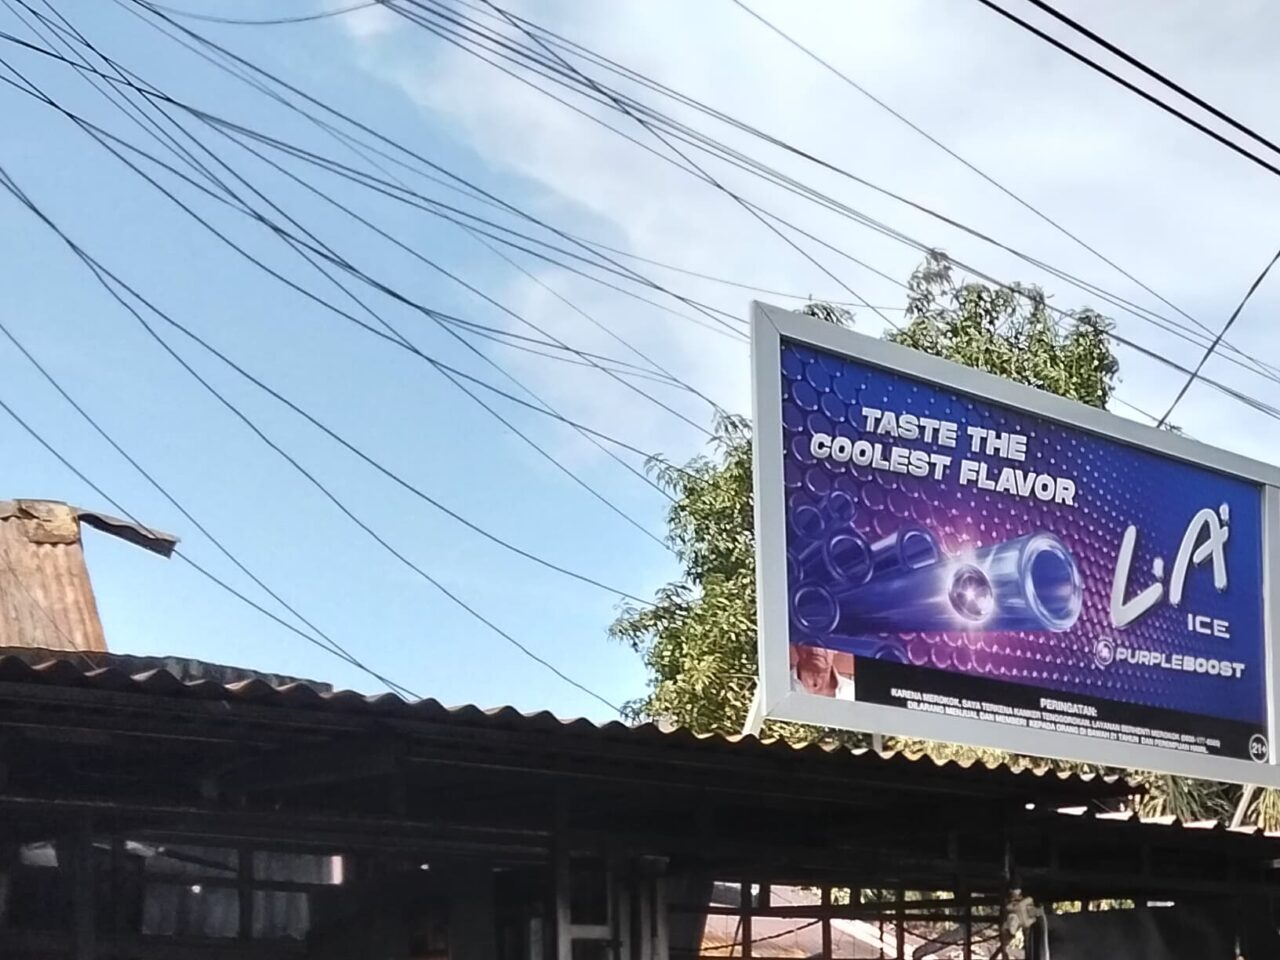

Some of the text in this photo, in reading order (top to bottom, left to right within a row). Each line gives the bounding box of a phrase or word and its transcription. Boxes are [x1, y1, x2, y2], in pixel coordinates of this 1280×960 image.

[861, 407, 1027, 461] TASTE THE
[810, 433, 1076, 505] COOLEST FLAVOR
[1187, 613, 1230, 639] ICE
[1115, 647, 1245, 678] PURPLEBOOST
[962, 699, 981, 710] SAYA
[1040, 698, 1097, 717] PERINGATAN:
